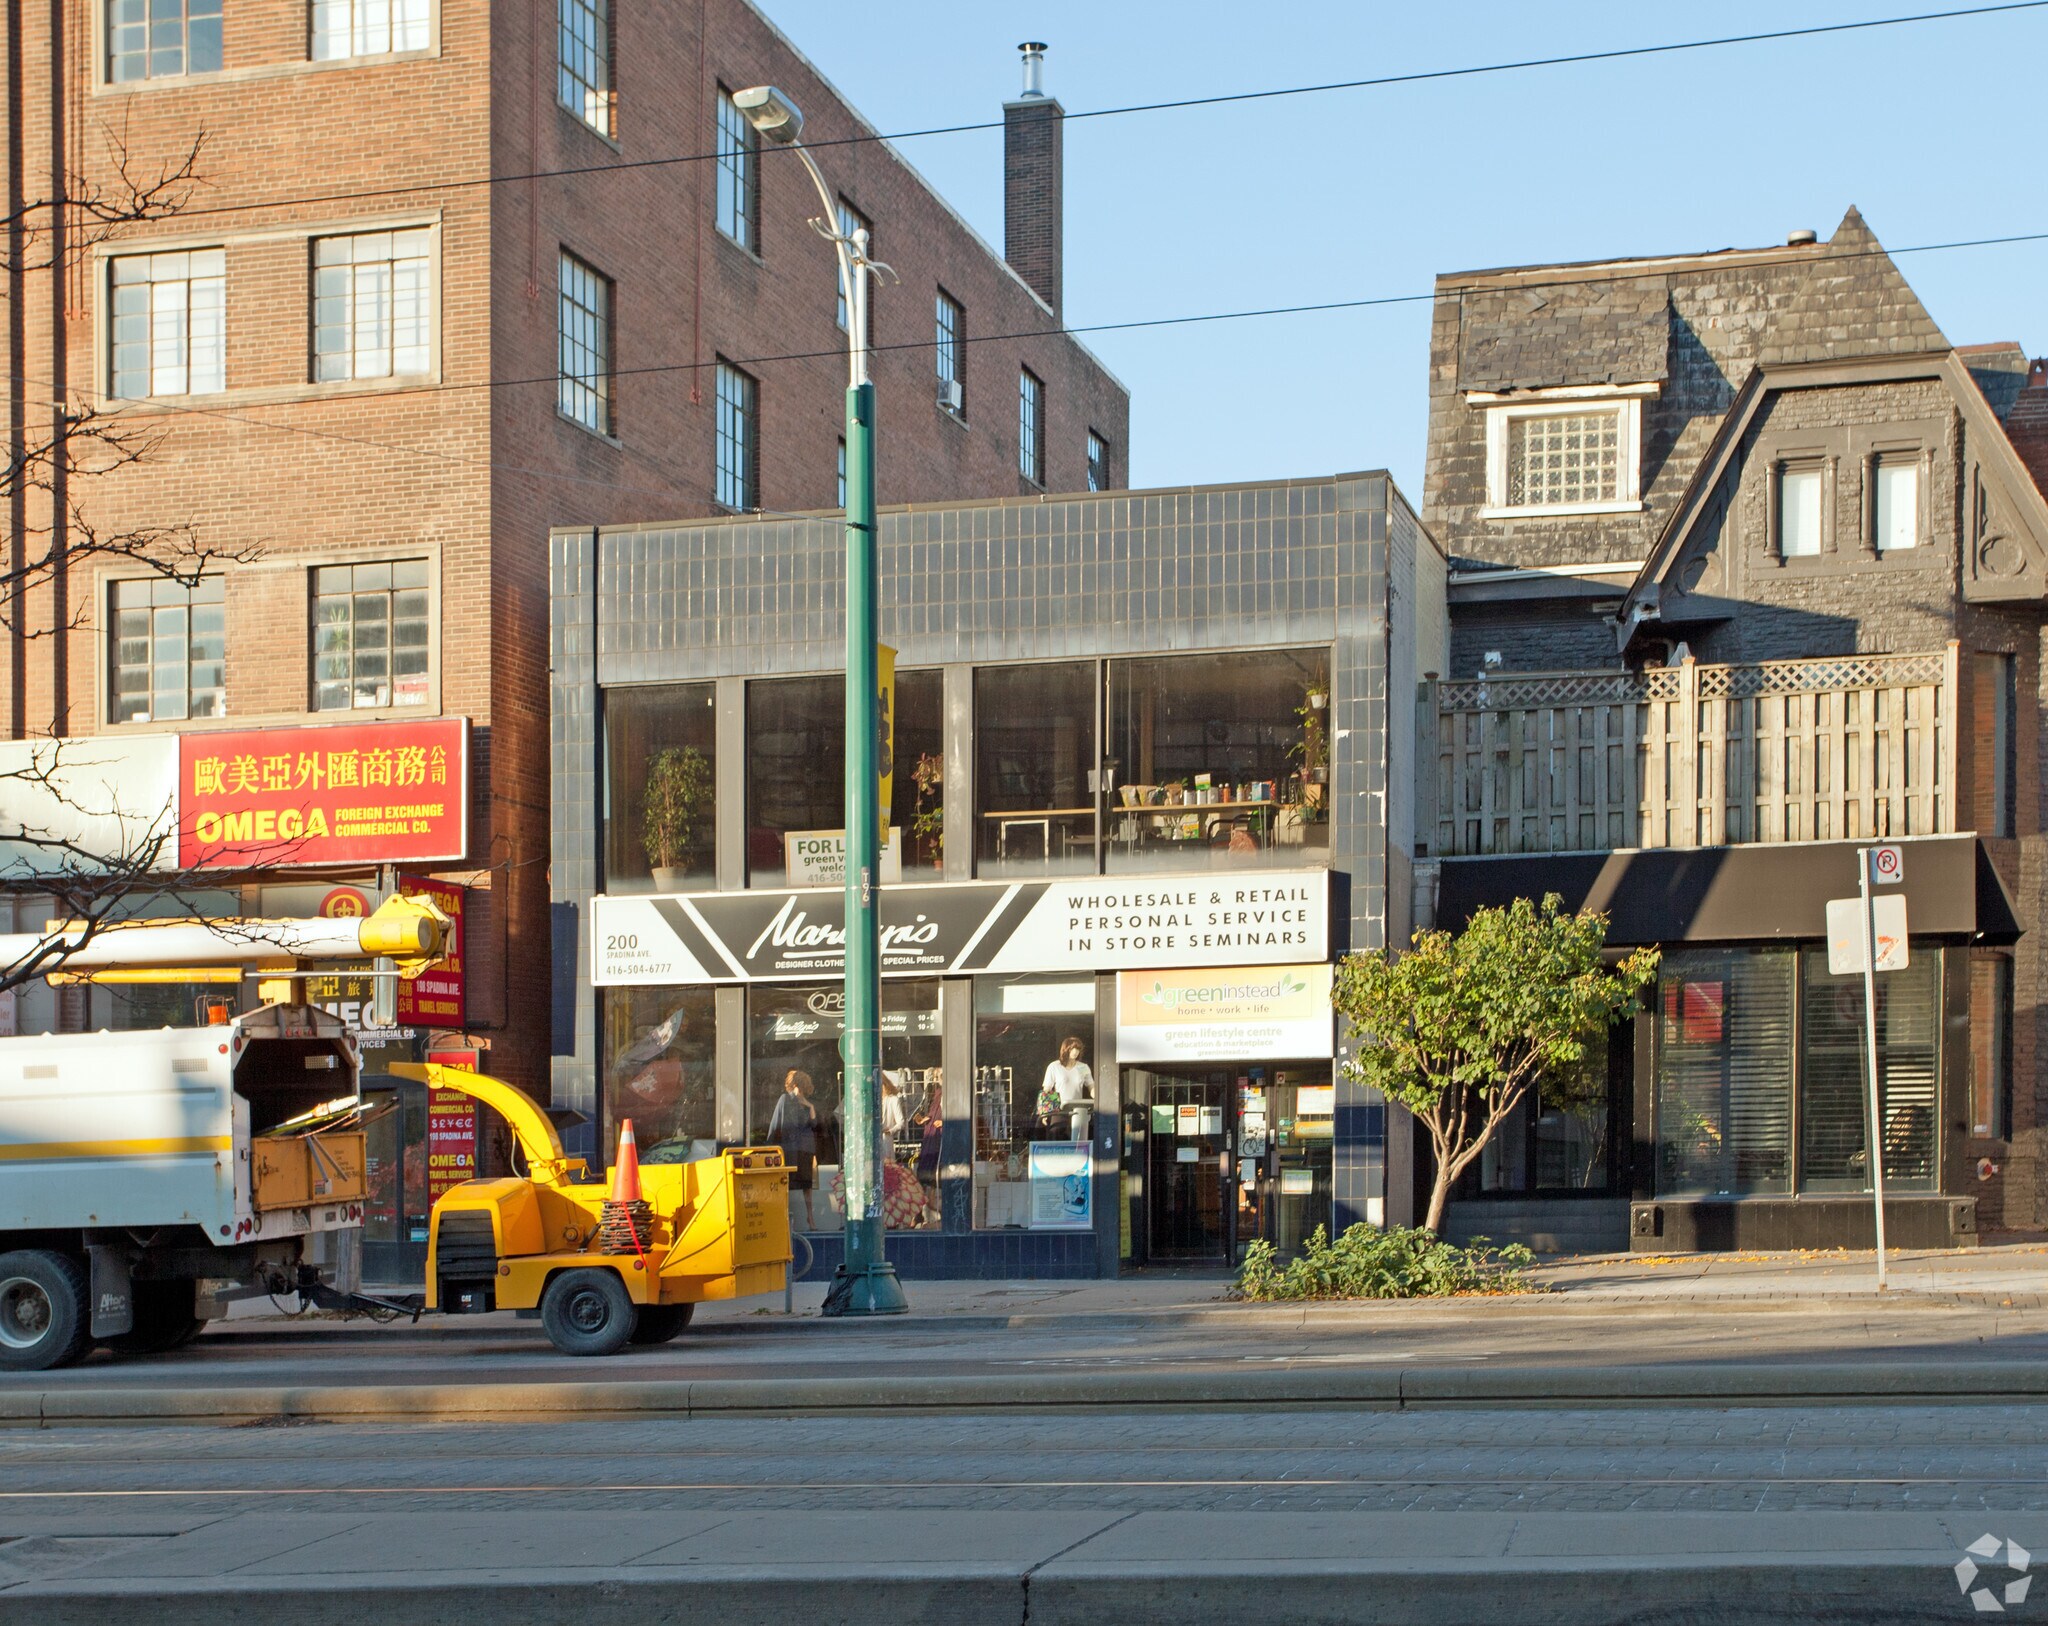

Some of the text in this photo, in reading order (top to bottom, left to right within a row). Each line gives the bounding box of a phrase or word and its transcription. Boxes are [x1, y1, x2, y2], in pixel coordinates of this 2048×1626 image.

[335, 804, 444, 822] FOREIGN EXCHANGE
[195, 807, 331, 844] OMEGA
[335, 820, 431, 837] COMMERCIAL CO.
[797, 839, 832, 855] FOR
[804, 855, 835, 867] green
[819, 863, 846, 873] welc
[862, 872, 870, 902] T96
[1068, 888, 1309, 909] WHOLESALE & RETAIL
[1069, 909, 1307, 930] PERSONAL SERVICE
[607, 934, 638, 950] 200
[1069, 931, 1307, 951] IN STORE SEMINARS
[606, 950, 652, 959] SPADINA AVE.
[606, 963, 672, 975] 416-504-6777
[775, 955, 945, 969] DESIGNER CLOTHE SPECIAL PRICES
[810, 992, 846, 1010] OPE
[1177, 1004, 1270, 1016] home work life
[887, 1015, 907, 1024] Friday
[404, 1029, 417, 1038] CO.
[1165, 1027, 1283, 1041] green lifestyle centre
[1174, 1040, 1214, 1049] education
[1223, 1038, 1274, 1049] marketplace
[429, 1104, 464, 1114] COMMERCIAL
[429, 1153, 475, 1167] OMEGA
